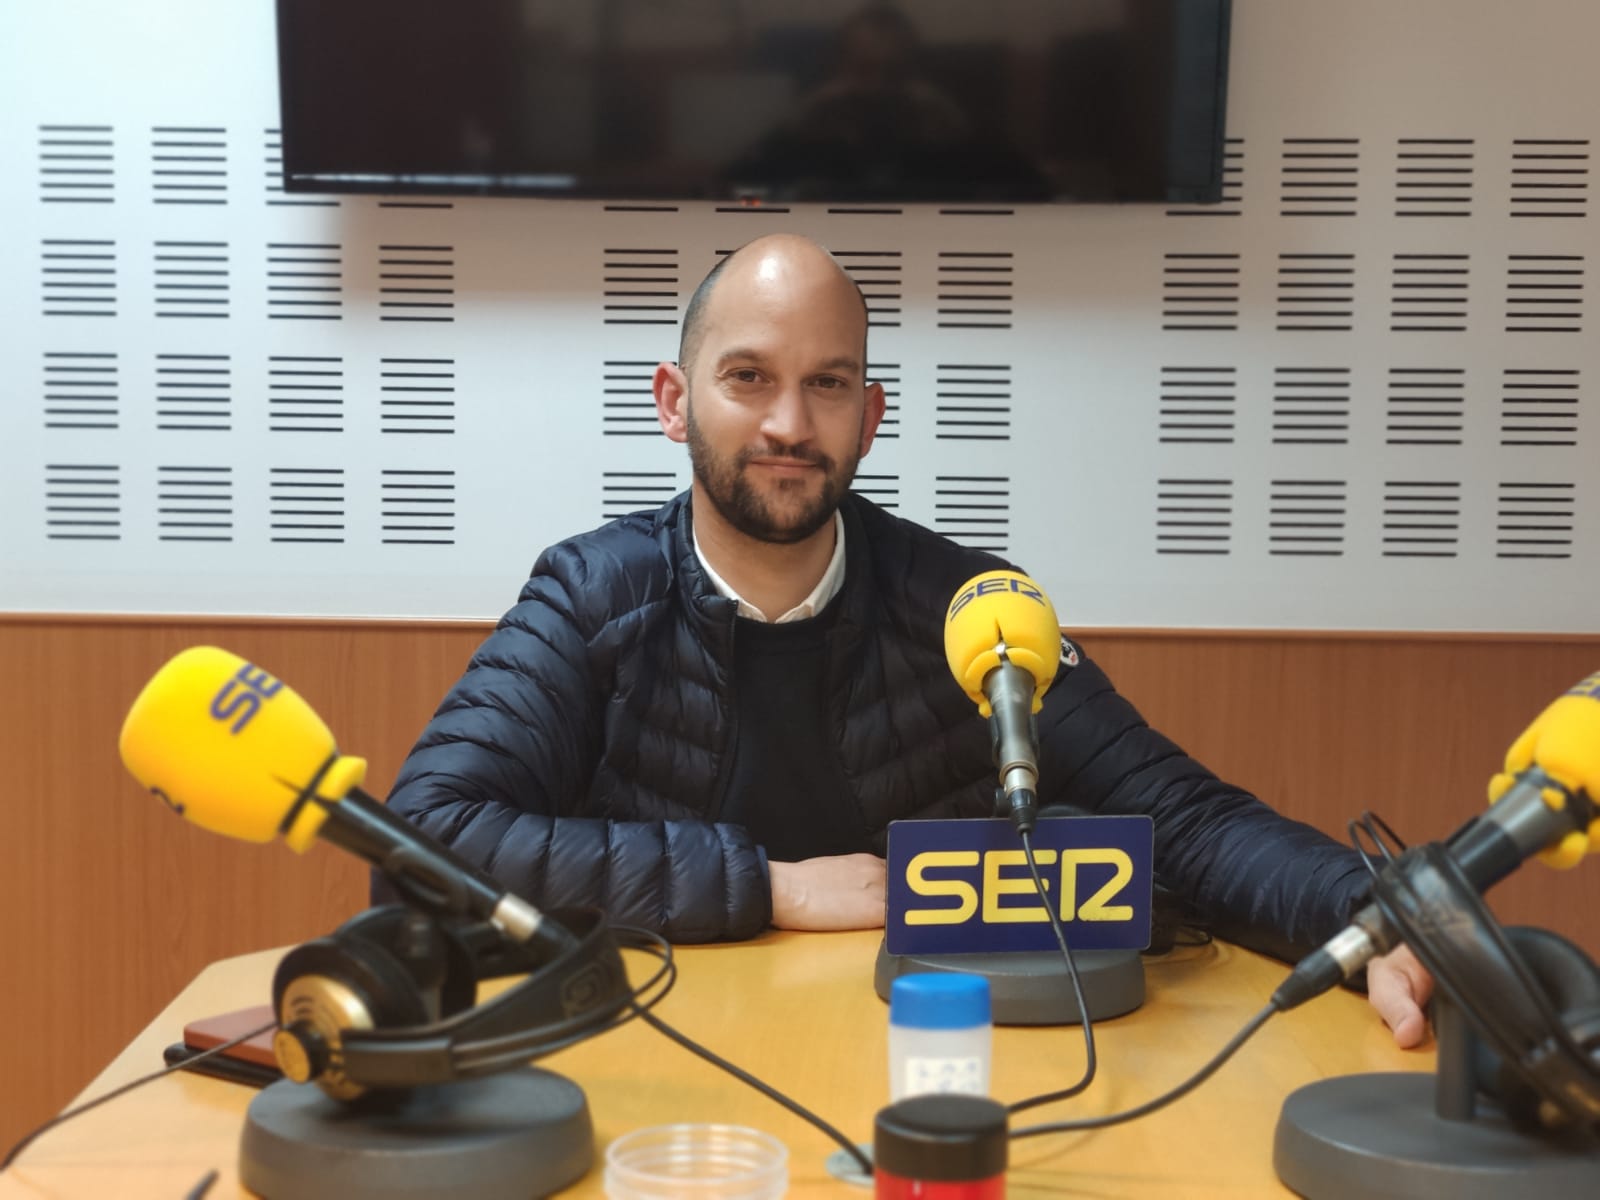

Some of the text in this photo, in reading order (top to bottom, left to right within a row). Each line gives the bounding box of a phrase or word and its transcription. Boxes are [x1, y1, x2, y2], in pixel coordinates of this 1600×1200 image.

[949, 577, 1047, 623] SER
[210, 662, 284, 735] SE
[904, 847, 1134, 926] SER
